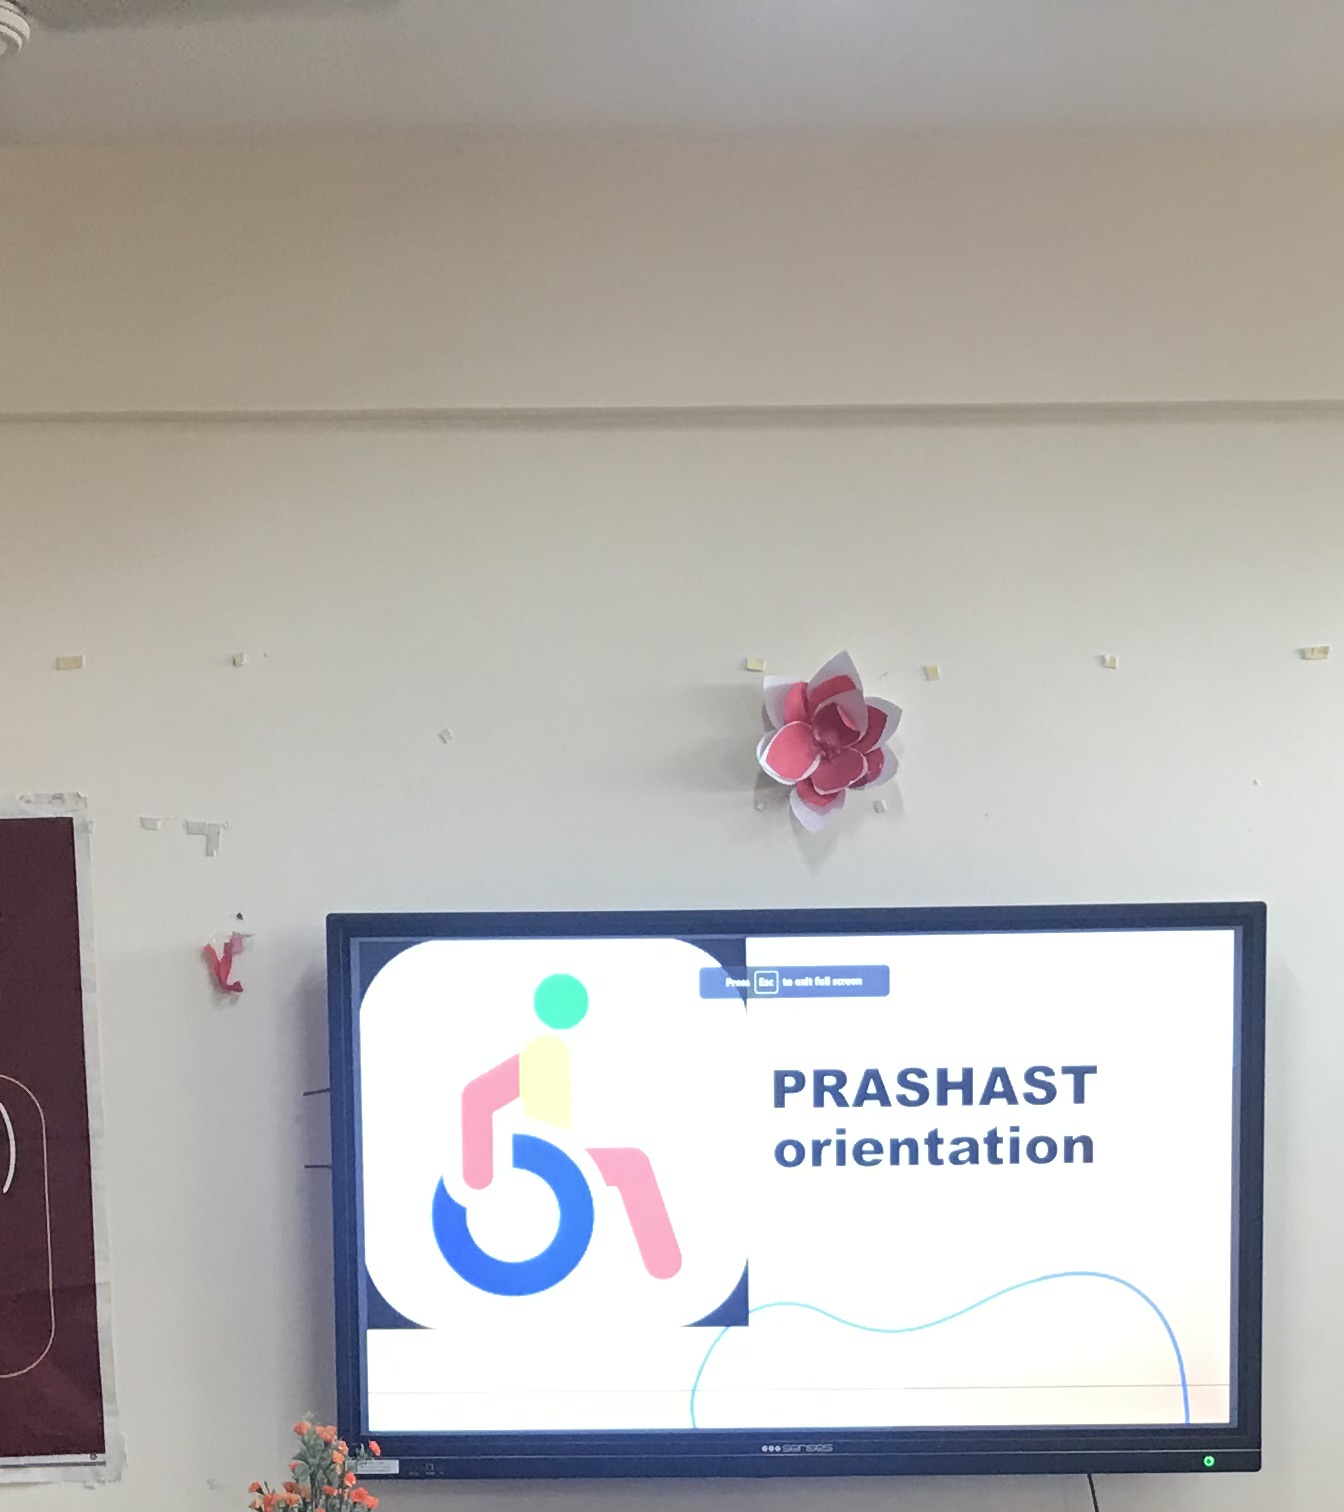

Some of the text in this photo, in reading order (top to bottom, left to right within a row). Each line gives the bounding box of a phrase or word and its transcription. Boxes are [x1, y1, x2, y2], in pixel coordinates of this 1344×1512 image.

[757, 976, 775, 988] Esc
[782, 977, 793, 987] to
[794, 976, 813, 987] exit
[814, 975, 831, 987] full
[832, 977, 863, 987] screen
[773, 1065, 1098, 1109] PRASHAST
[774, 1125, 1094, 1168] orientation
